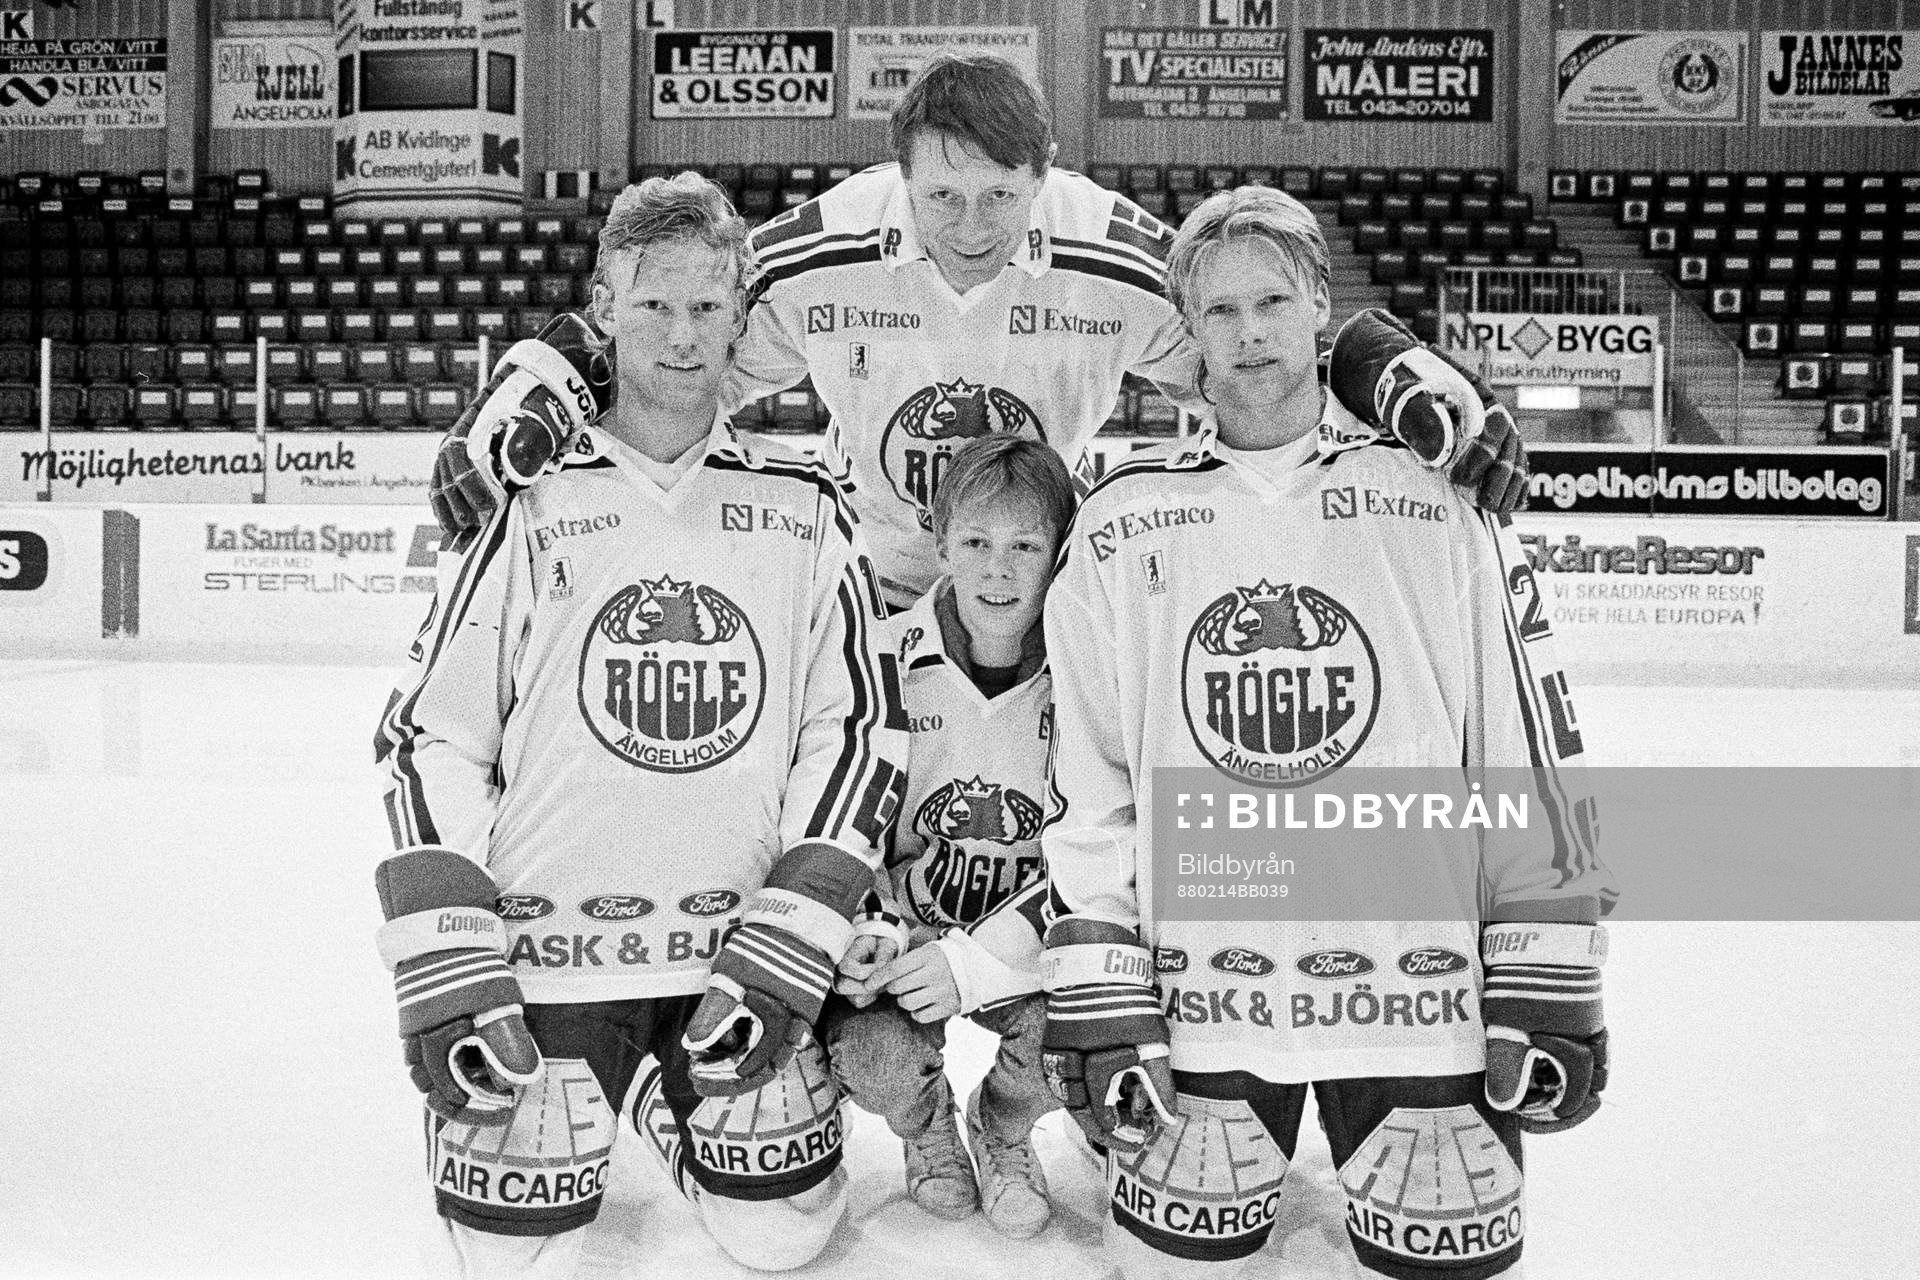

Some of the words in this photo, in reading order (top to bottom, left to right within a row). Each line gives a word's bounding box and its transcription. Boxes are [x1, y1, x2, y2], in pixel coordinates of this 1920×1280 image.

[4, 13, 28, 38] K
[571, 0, 596, 28] K
[646, 0, 664, 27] L
[1209, 0, 1229, 25] L
[1243, 0, 1272, 26] M
[360, 24, 477, 42] kontorsservice
[0, 42, 38, 55] HEJA
[45, 40, 64, 54] PÅ
[671, 46, 816, 74] LEEMAN
[1312, 36, 1365, 60] John
[10, 59, 72, 72] HANDLA
[1317, 58, 1479, 97] MÅLERI
[1768, 35, 1903, 95] JANNES
[62, 76, 163, 96] SERVUS
[659, 79, 679, 104] &
[687, 78, 828, 103] OLSSON
[1795, 71, 1890, 95] BILDELAR
[365, 130, 392, 149] AB
[398, 130, 471, 152] Kvidinge
[843, 306, 920, 330] Extraco
[1043, 308, 1122, 336] Extraco
[1557, 324, 1652, 353] BYGG
[21, 447, 264, 488] Möjligheternas
[276, 441, 356, 472] bank
[1529, 467, 1729, 509] ngelholms
[1734, 468, 1882, 512] bilbolag
[1118, 506, 1215, 540] Extraco
[204, 573, 395, 593] STERLING
[1707, 584, 1764, 601] RESOR
[604, 651, 747, 741] RÖGLE
[1204, 661, 1356, 756] RÖGLE
[615, 727, 738, 766] ÄNGELHOLM
[1219, 739, 1347, 782] ÄNGELHOLM
[592, 897, 642, 917] Ford
[690, 892, 731, 912] Ford
[437, 912, 497, 934] Cooper
[507, 934, 604, 967] ASK
[617, 934, 652, 965] &
[1225, 950, 1263, 973] Ford
[1311, 949, 1359, 973] Ford
[1410, 949, 1453, 972] Ford
[1167, 987, 1241, 1025] ASK
[1249, 990, 1276, 1030] &
[1292, 983, 1469, 1029] BJÖRCK
[700, 1140, 749, 1173] AIR
[440, 1157, 490, 1200] AIR
[1115, 1174, 1156, 1223] AIR
[1403, 1208, 1521, 1257] CARGO
